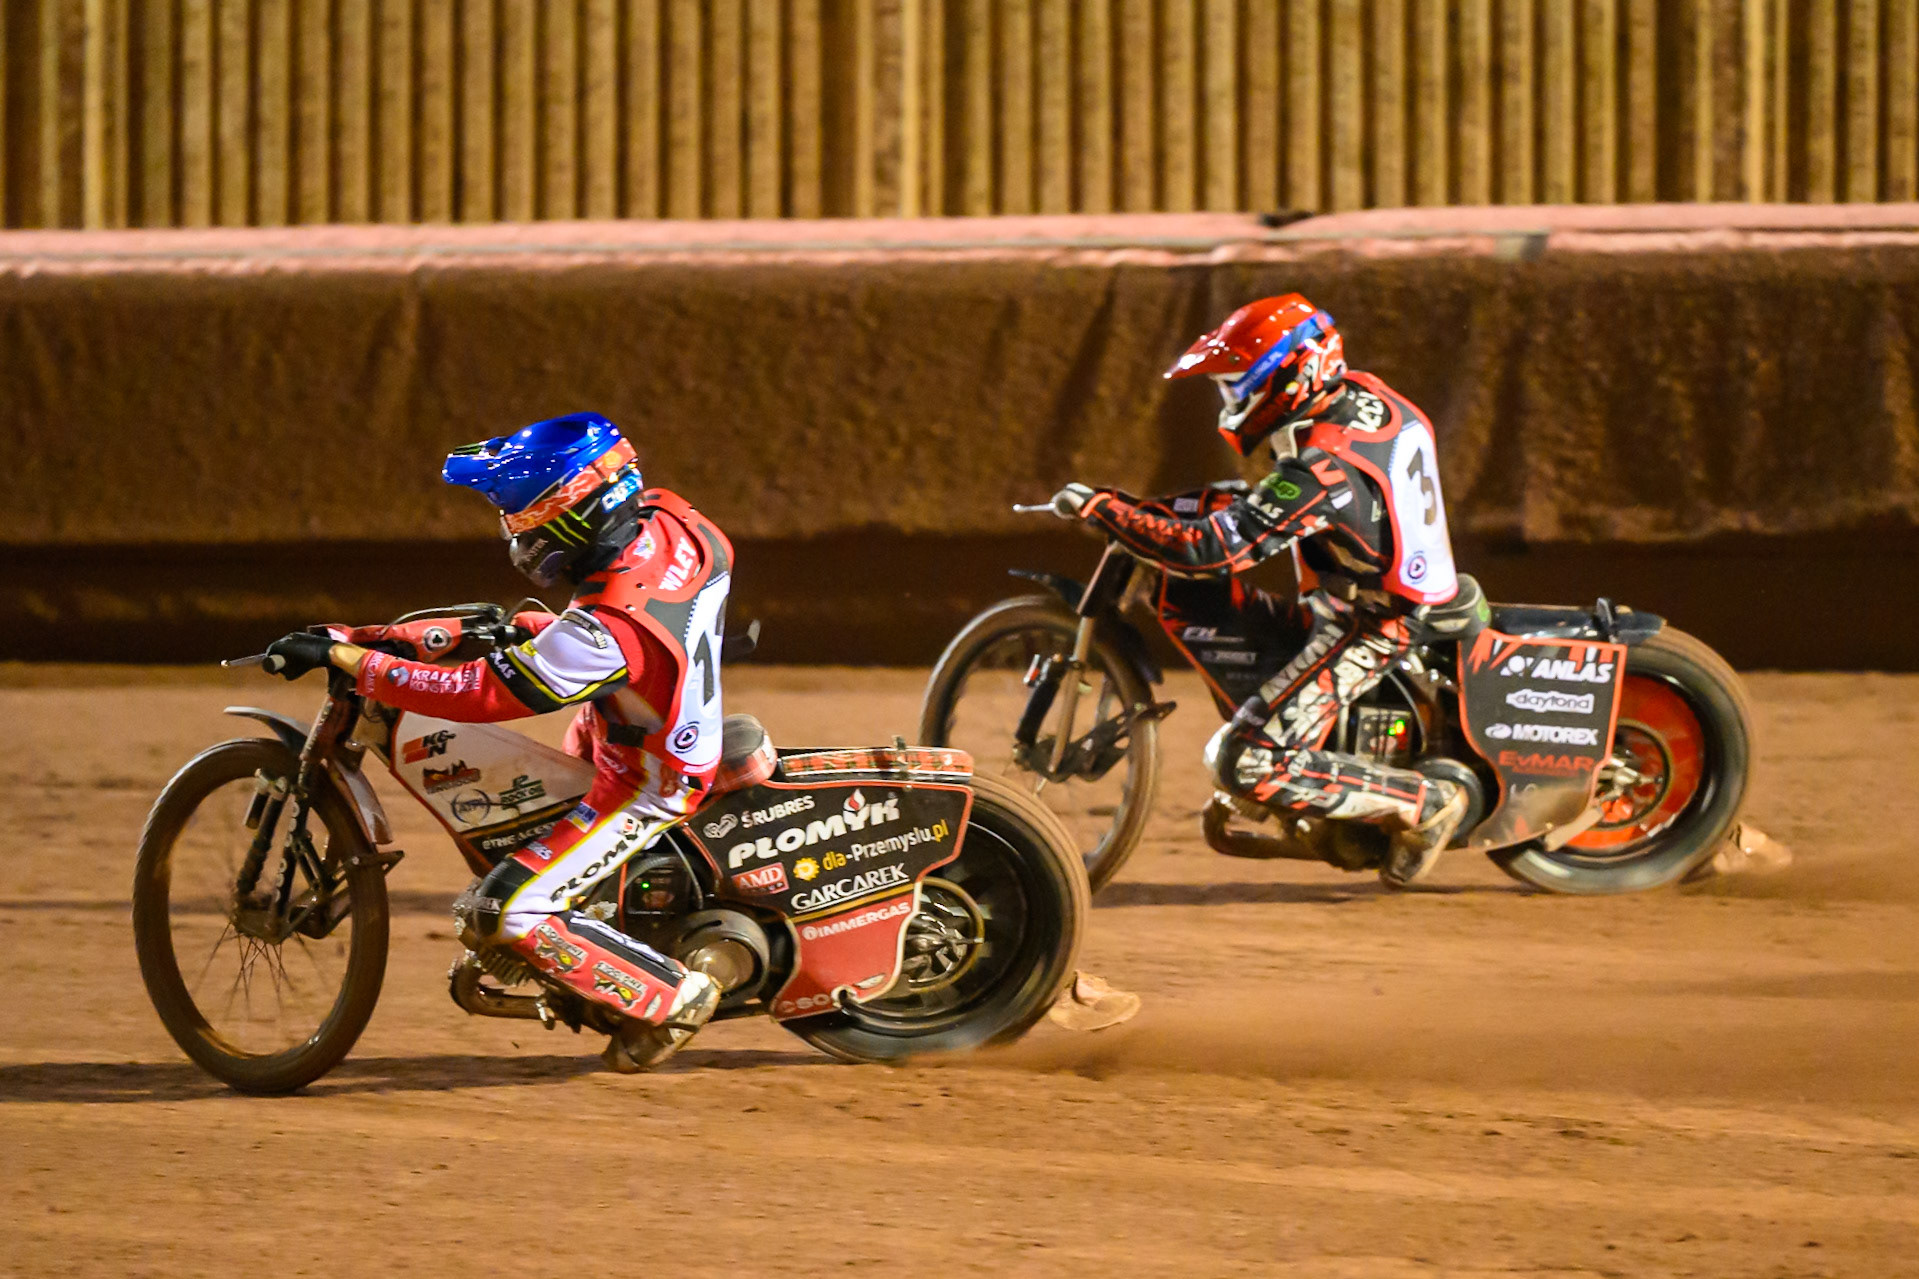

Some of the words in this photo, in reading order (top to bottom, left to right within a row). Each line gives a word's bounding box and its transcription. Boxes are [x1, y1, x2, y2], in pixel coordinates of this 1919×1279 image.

[1407, 447, 1437, 525] 3
[693, 631, 714, 706] 1
[1531, 658, 1614, 683] ANLAS
[1516, 692, 1590, 709] daytona
[1512, 724, 1599, 745] MOTOREX
[741, 795, 815, 828] ŚRUBRES
[739, 866, 783, 888] AMD
[791, 863, 908, 911] GARCAREK
[817, 902, 911, 938] IMMERGAS
